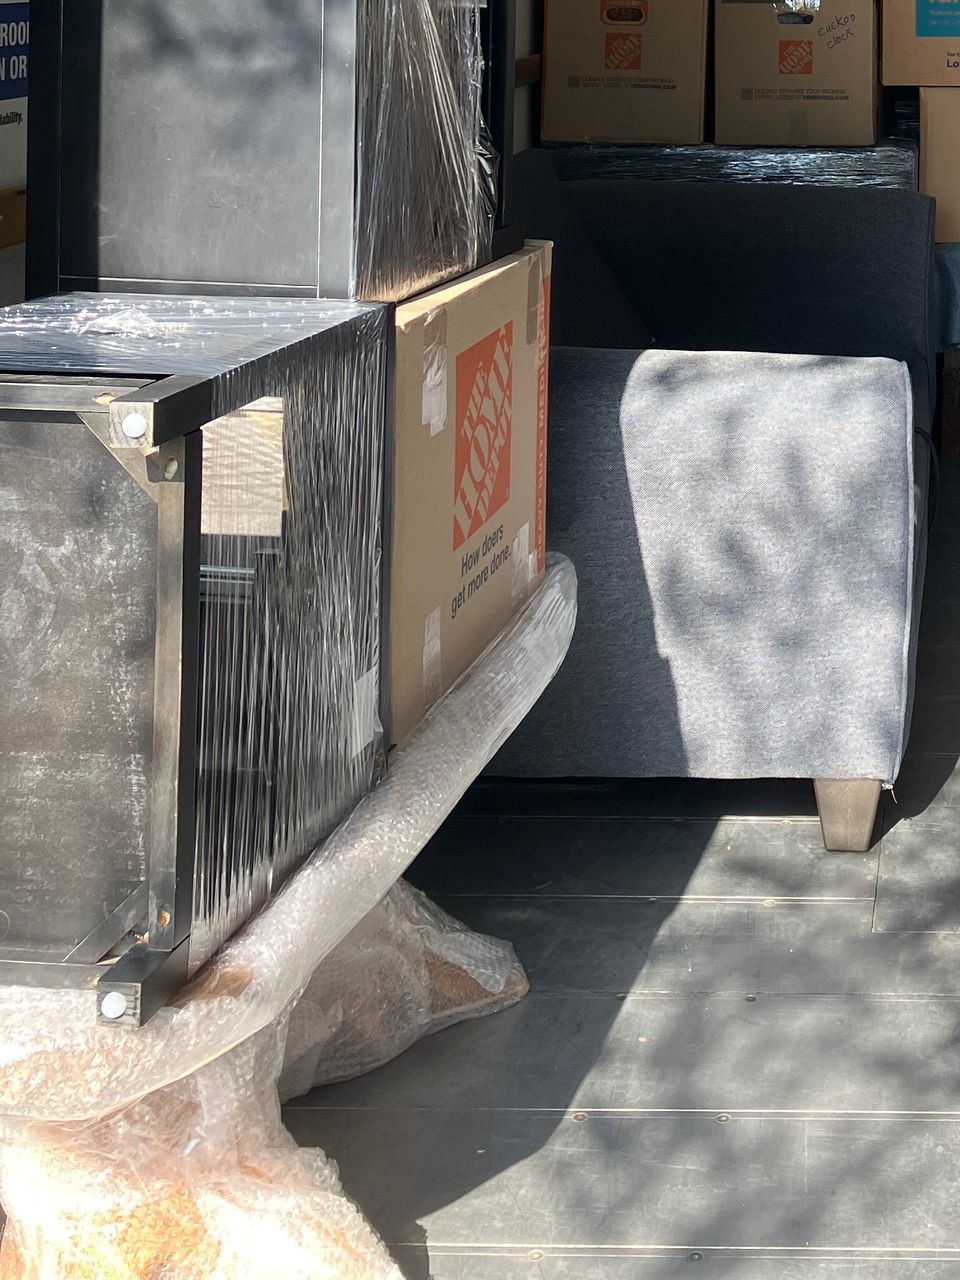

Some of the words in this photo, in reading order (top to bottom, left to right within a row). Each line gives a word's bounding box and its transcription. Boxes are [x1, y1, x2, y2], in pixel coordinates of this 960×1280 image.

[817, 13, 857, 37] cuckoo
[826, 28, 855, 50] clock
[453, 326, 512, 540] HOME
[460, 548, 481, 578] How
[481, 523, 505, 557] doers
[451, 589, 466, 620] get
[467, 564, 489, 599] more
